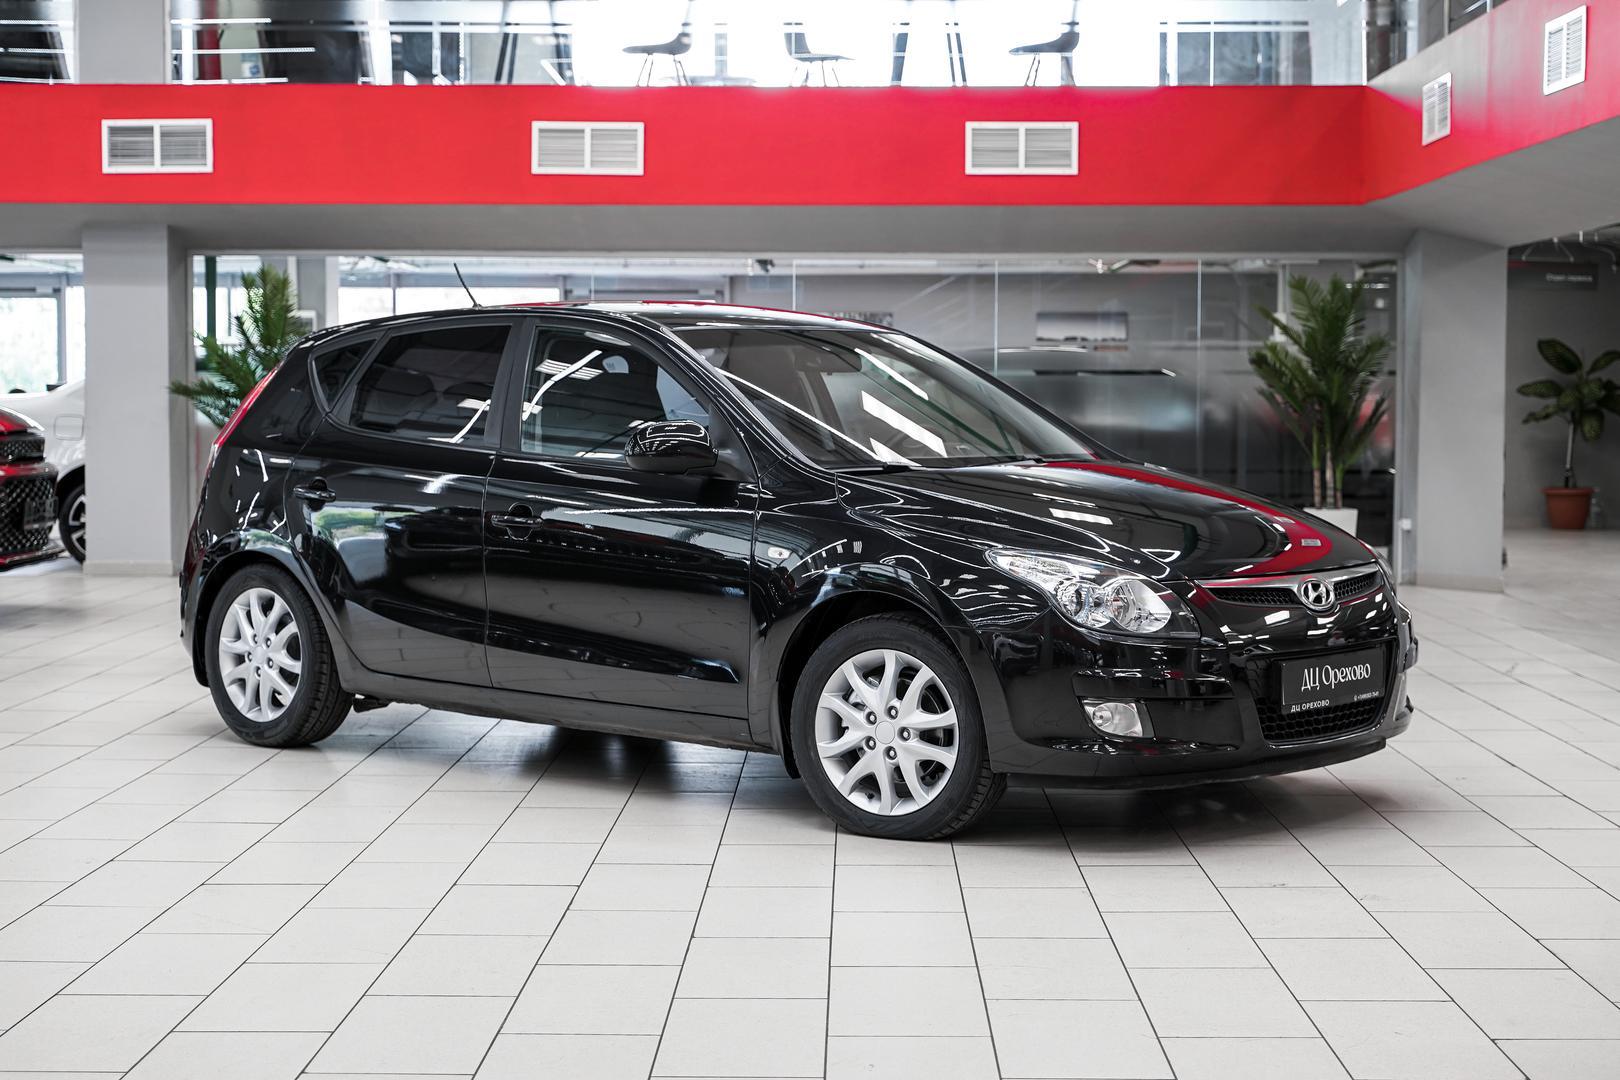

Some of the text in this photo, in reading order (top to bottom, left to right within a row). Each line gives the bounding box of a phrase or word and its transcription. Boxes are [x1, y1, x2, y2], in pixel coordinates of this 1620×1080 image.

[1301, 663, 1371, 692] ДЦ Орехово
[1290, 699, 1330, 713] ДЦ ОРЕХОВО
